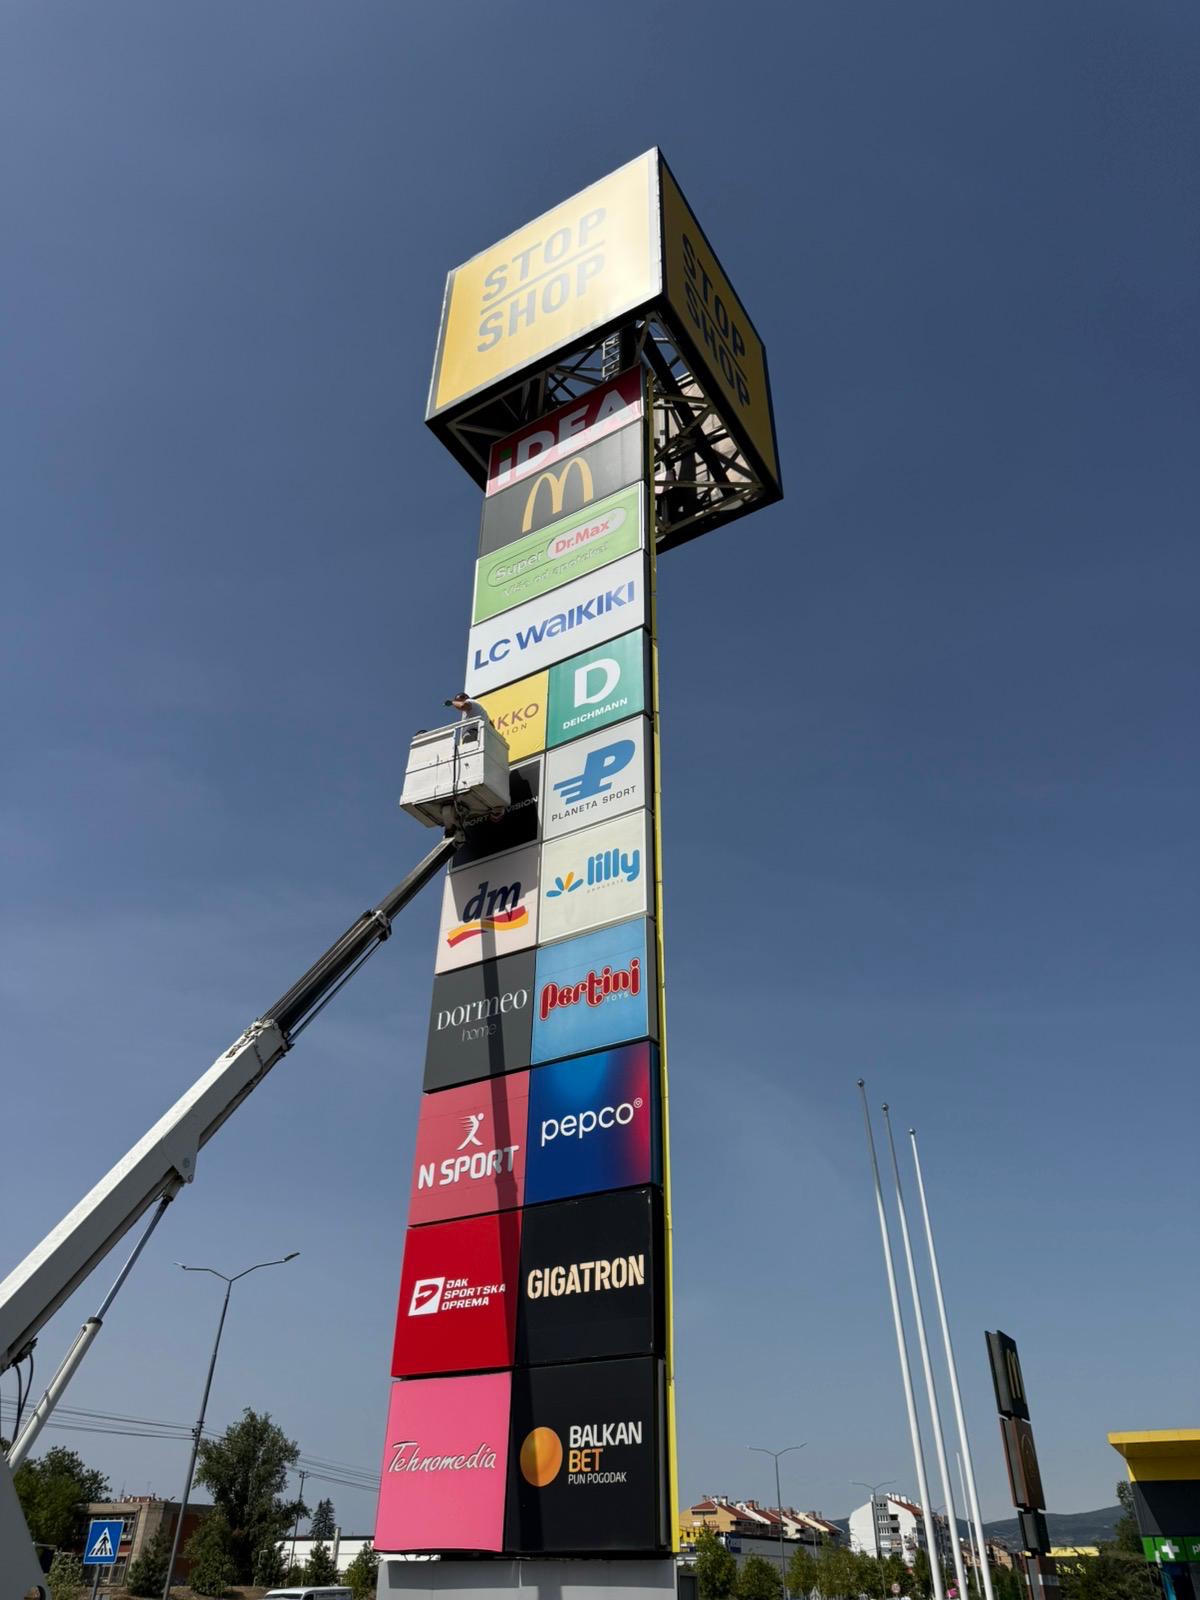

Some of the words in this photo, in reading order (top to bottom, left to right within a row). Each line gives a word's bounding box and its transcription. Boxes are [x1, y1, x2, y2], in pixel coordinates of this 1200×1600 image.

[482, 207, 606, 302] STOP
[477, 253, 605, 353] SHOP
[682, 233, 745, 357] STOP
[685, 281, 749, 407] SHOP
[495, 550, 544, 580] Super
[555, 521, 610, 553] Dr.Max
[474, 638, 511, 670] LC
[574, 658, 621, 708] D
[492, 703, 540, 730] KKO
[563, 697, 628, 730] DEICHMANN
[506, 796, 538, 813] VISION
[551, 801, 598, 822] PLANETA
[602, 785, 637, 804] SPORT
[588, 848, 640, 882] lilly
[462, 879, 521, 924] dm
[462, 1023, 497, 1042] home
[541, 1102, 634, 1147] pepco
[418, 1162, 435, 1190] N
[439, 1145, 519, 1186] SPORT
[444, 1283, 506, 1300] SPORTSKA
[527, 1254, 645, 1299] GIGATRON
[441, 1296, 489, 1311] OPREMA
[569, 1421, 643, 1449] BALKAN
[388, 1440, 497, 1473] Tehnomedia
[569, 1448, 603, 1473] BET
[568, 1473, 586, 1485] PUN
[587, 1471, 627, 1484] POGODAK
